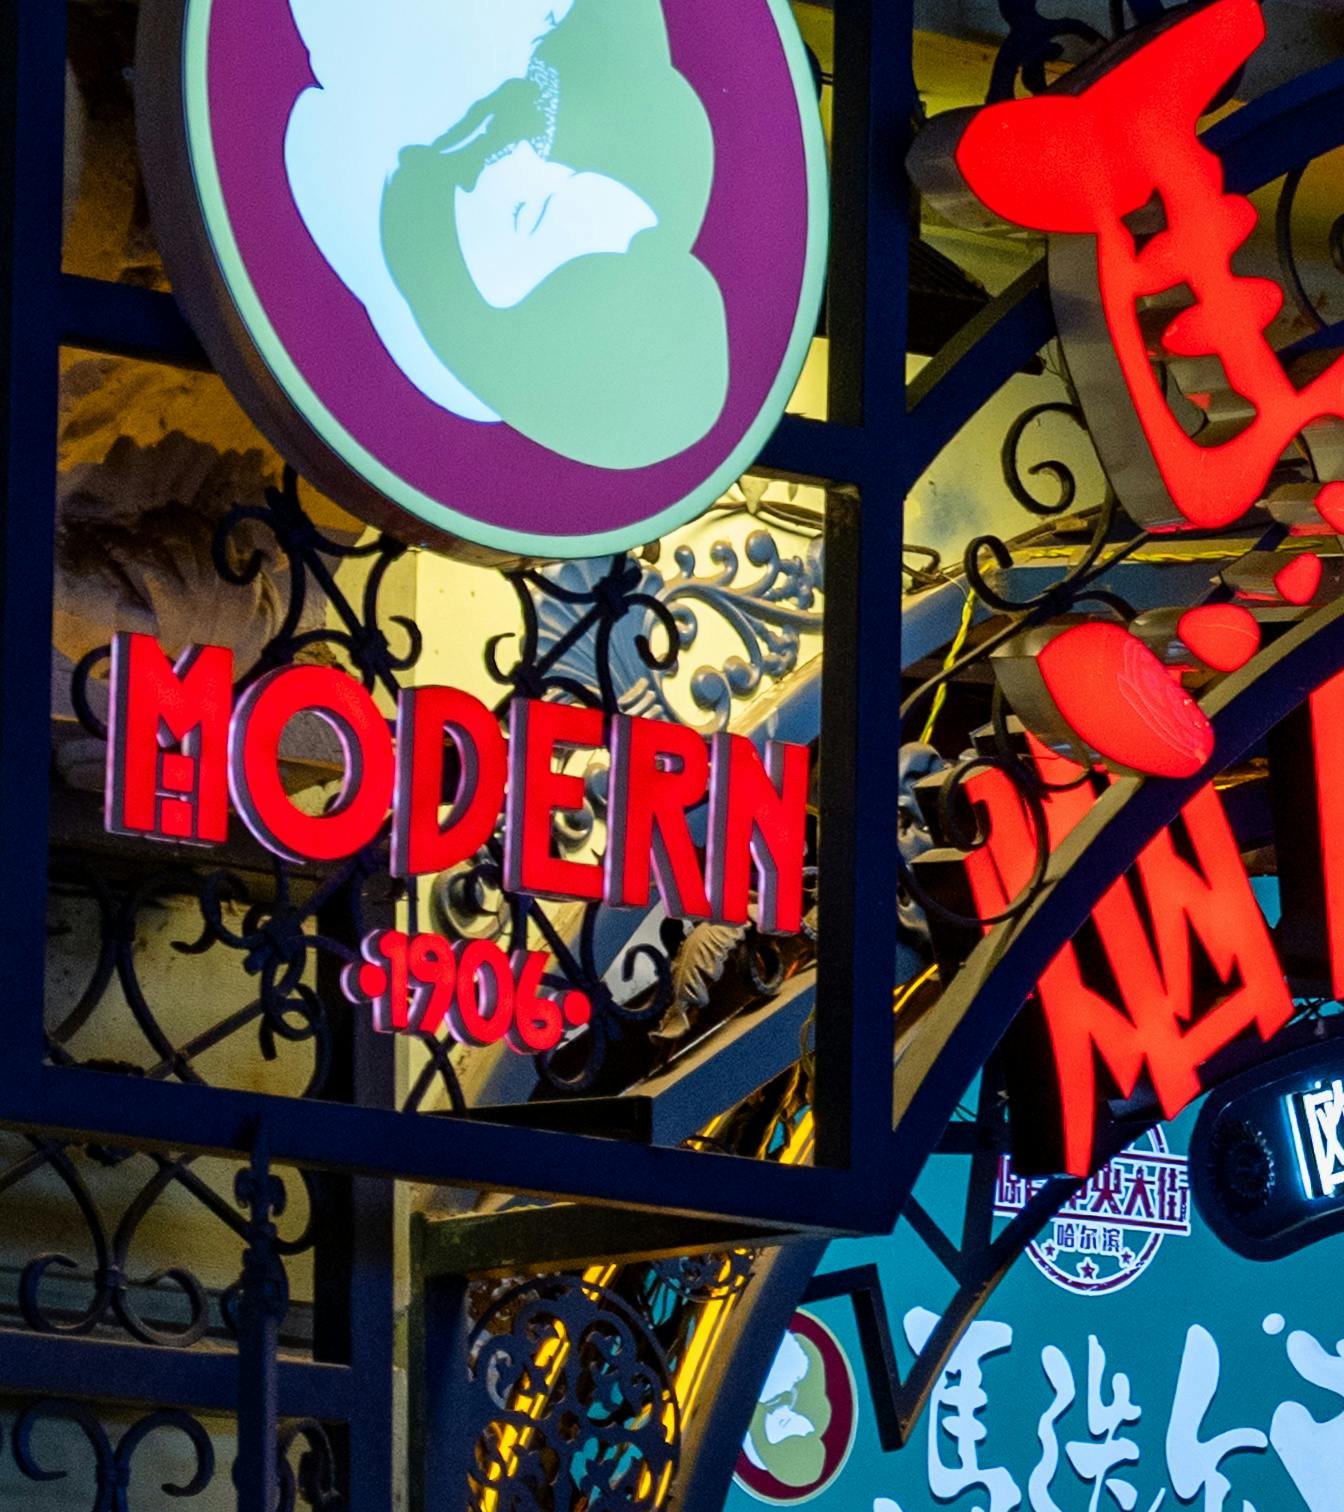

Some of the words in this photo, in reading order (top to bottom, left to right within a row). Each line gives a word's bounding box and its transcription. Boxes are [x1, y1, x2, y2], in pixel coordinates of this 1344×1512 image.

[108, 631, 811, 934] MODERN
[1056, 1223, 1123, 1253] 哈尔滨
